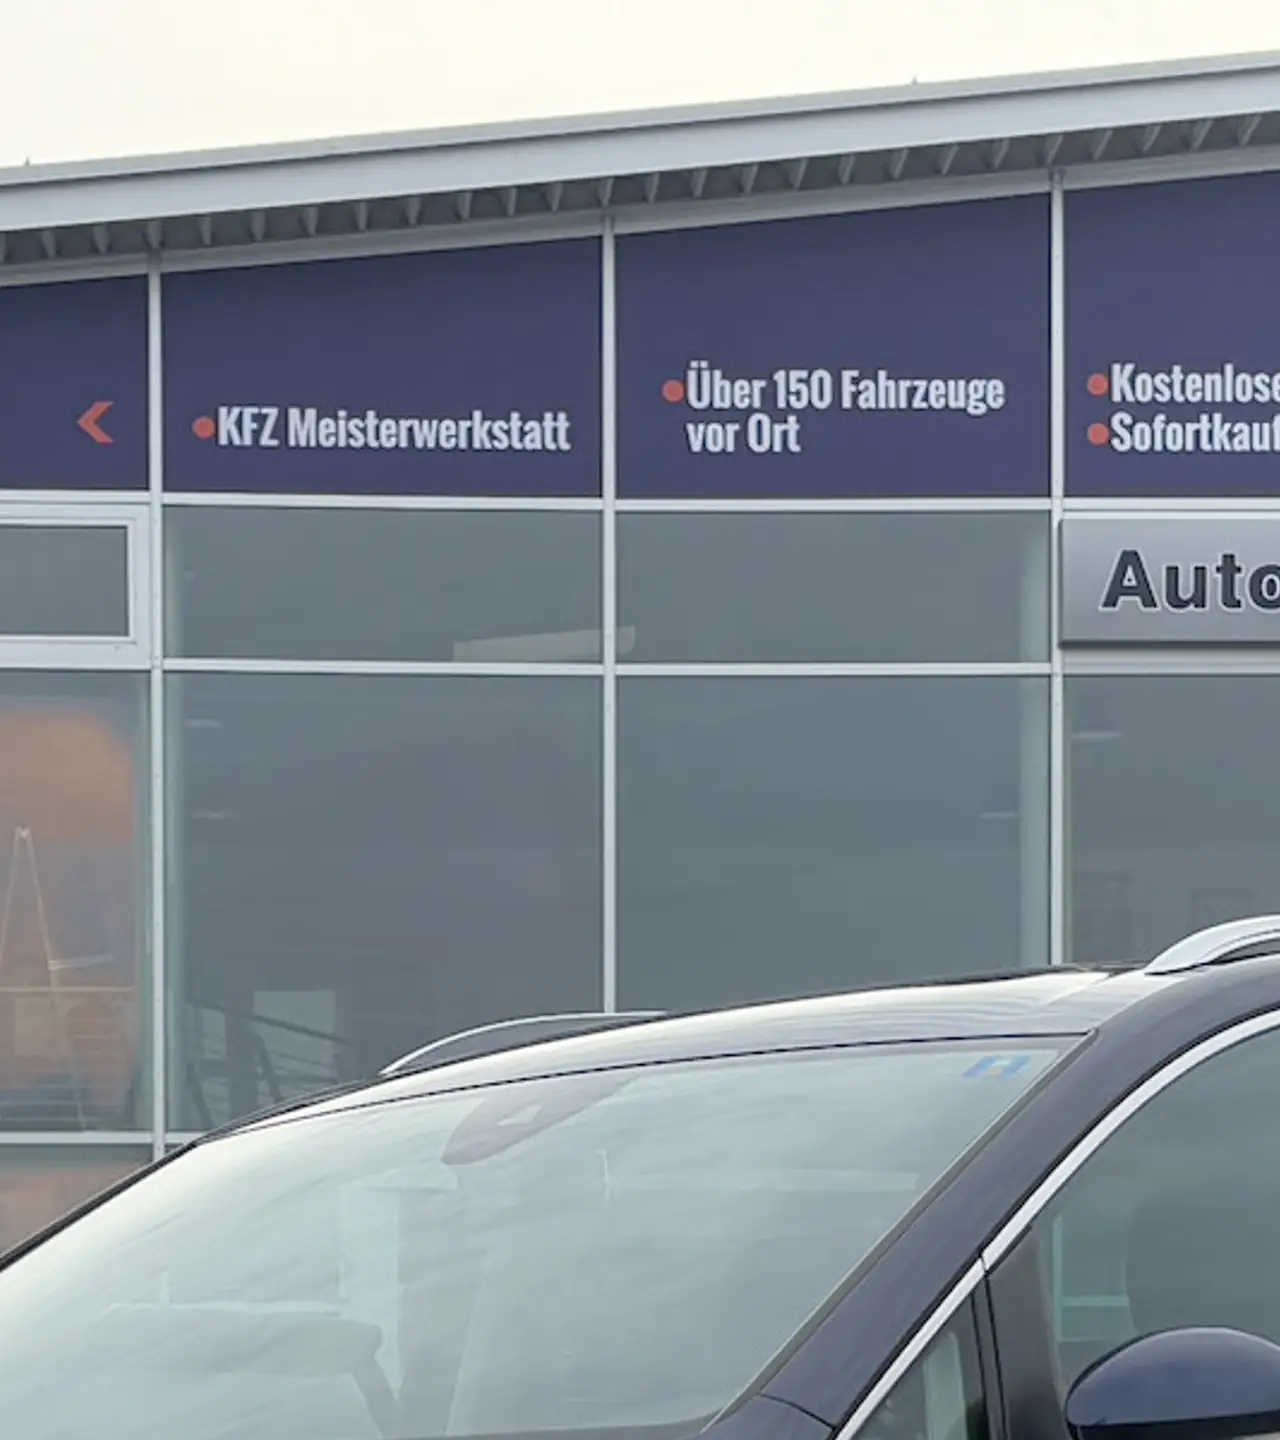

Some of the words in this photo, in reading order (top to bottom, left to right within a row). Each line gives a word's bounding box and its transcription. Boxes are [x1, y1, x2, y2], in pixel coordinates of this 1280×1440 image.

[687, 360, 767, 409] Über
[773, 368, 833, 410] 150
[841, 369, 1005, 416] Fahrzeuge
[218, 406, 280, 447] KFZ
[287, 407, 572, 451] Meisterwerkstatt
[686, 422, 741, 453] vor
[747, 412, 801, 453] Ort
